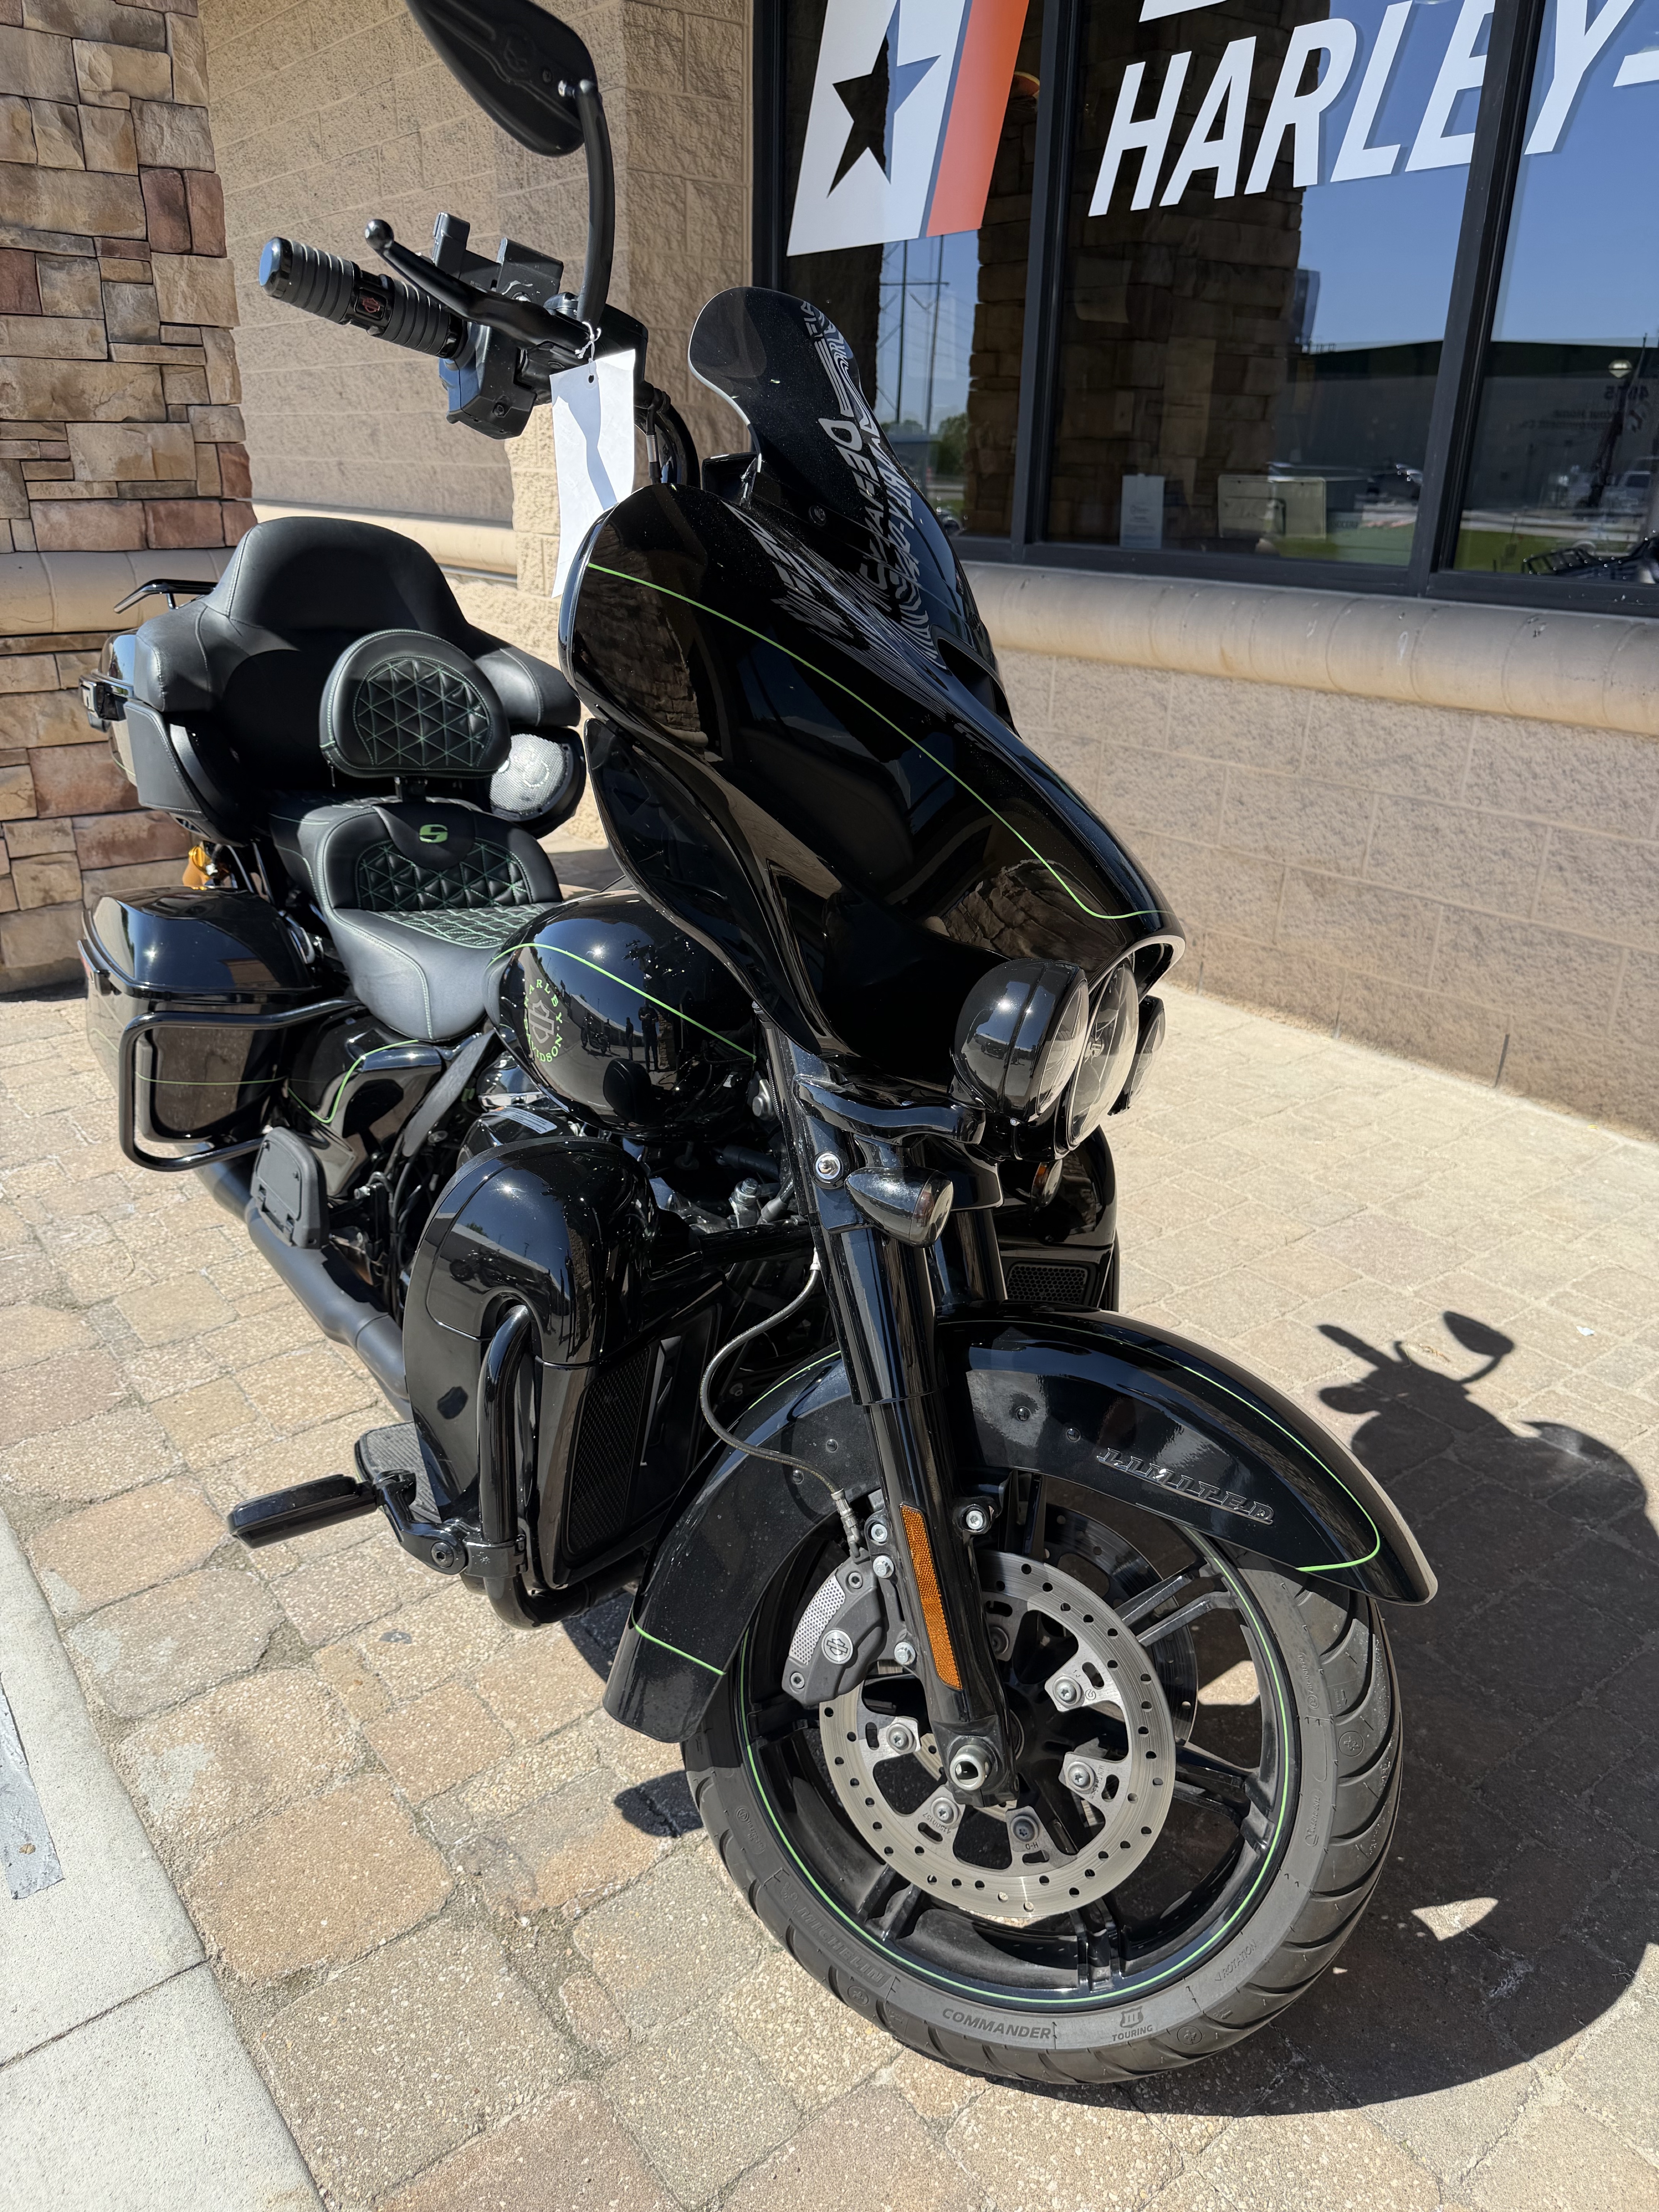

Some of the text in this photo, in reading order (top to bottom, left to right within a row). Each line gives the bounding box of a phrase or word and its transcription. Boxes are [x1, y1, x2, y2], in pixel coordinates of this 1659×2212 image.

[1097, 1448, 1274, 1524] LIMITED
[1025, 1841, 1038, 1849] H-D
[797, 1907, 884, 1984] MICHELIN
[1222, 1939, 1257, 1979] ROTATION
[942, 2008, 1052, 2040] COMMANDER
[1112, 2024, 1153, 2042] TOURING
